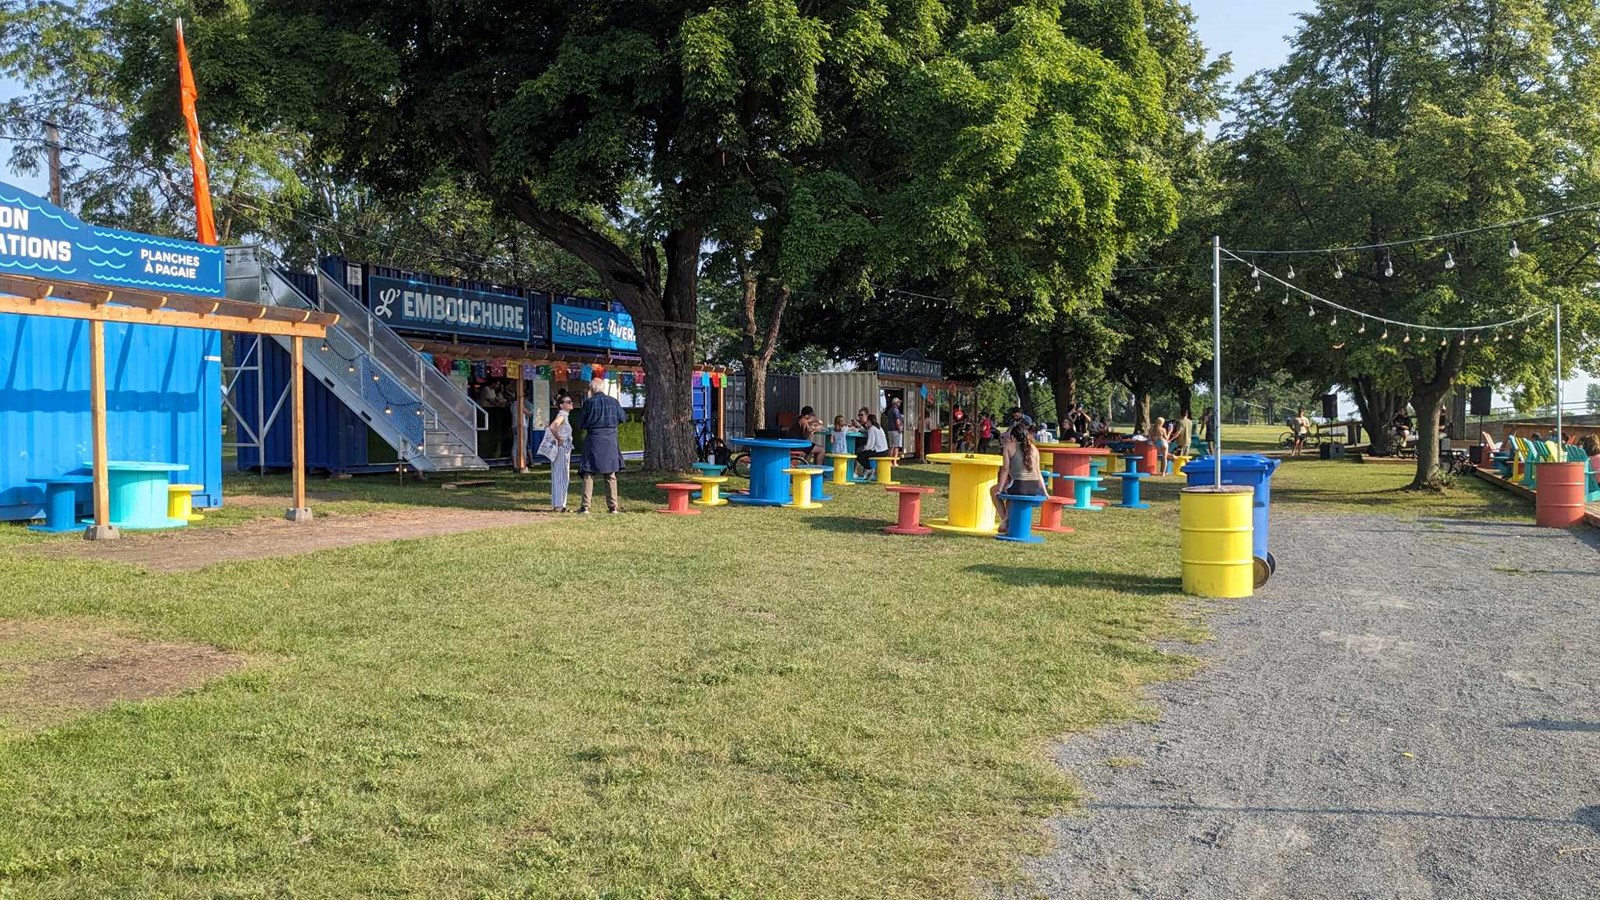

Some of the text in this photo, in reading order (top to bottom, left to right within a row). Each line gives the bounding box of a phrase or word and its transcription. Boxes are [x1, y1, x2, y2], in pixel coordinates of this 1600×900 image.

[140, 248, 200, 267] PLANCHES
[144, 259, 197, 279] À PAGAIE
[555, 311, 605, 337] TERRASSE
[880, 356, 909, 373] KIOSQUE
